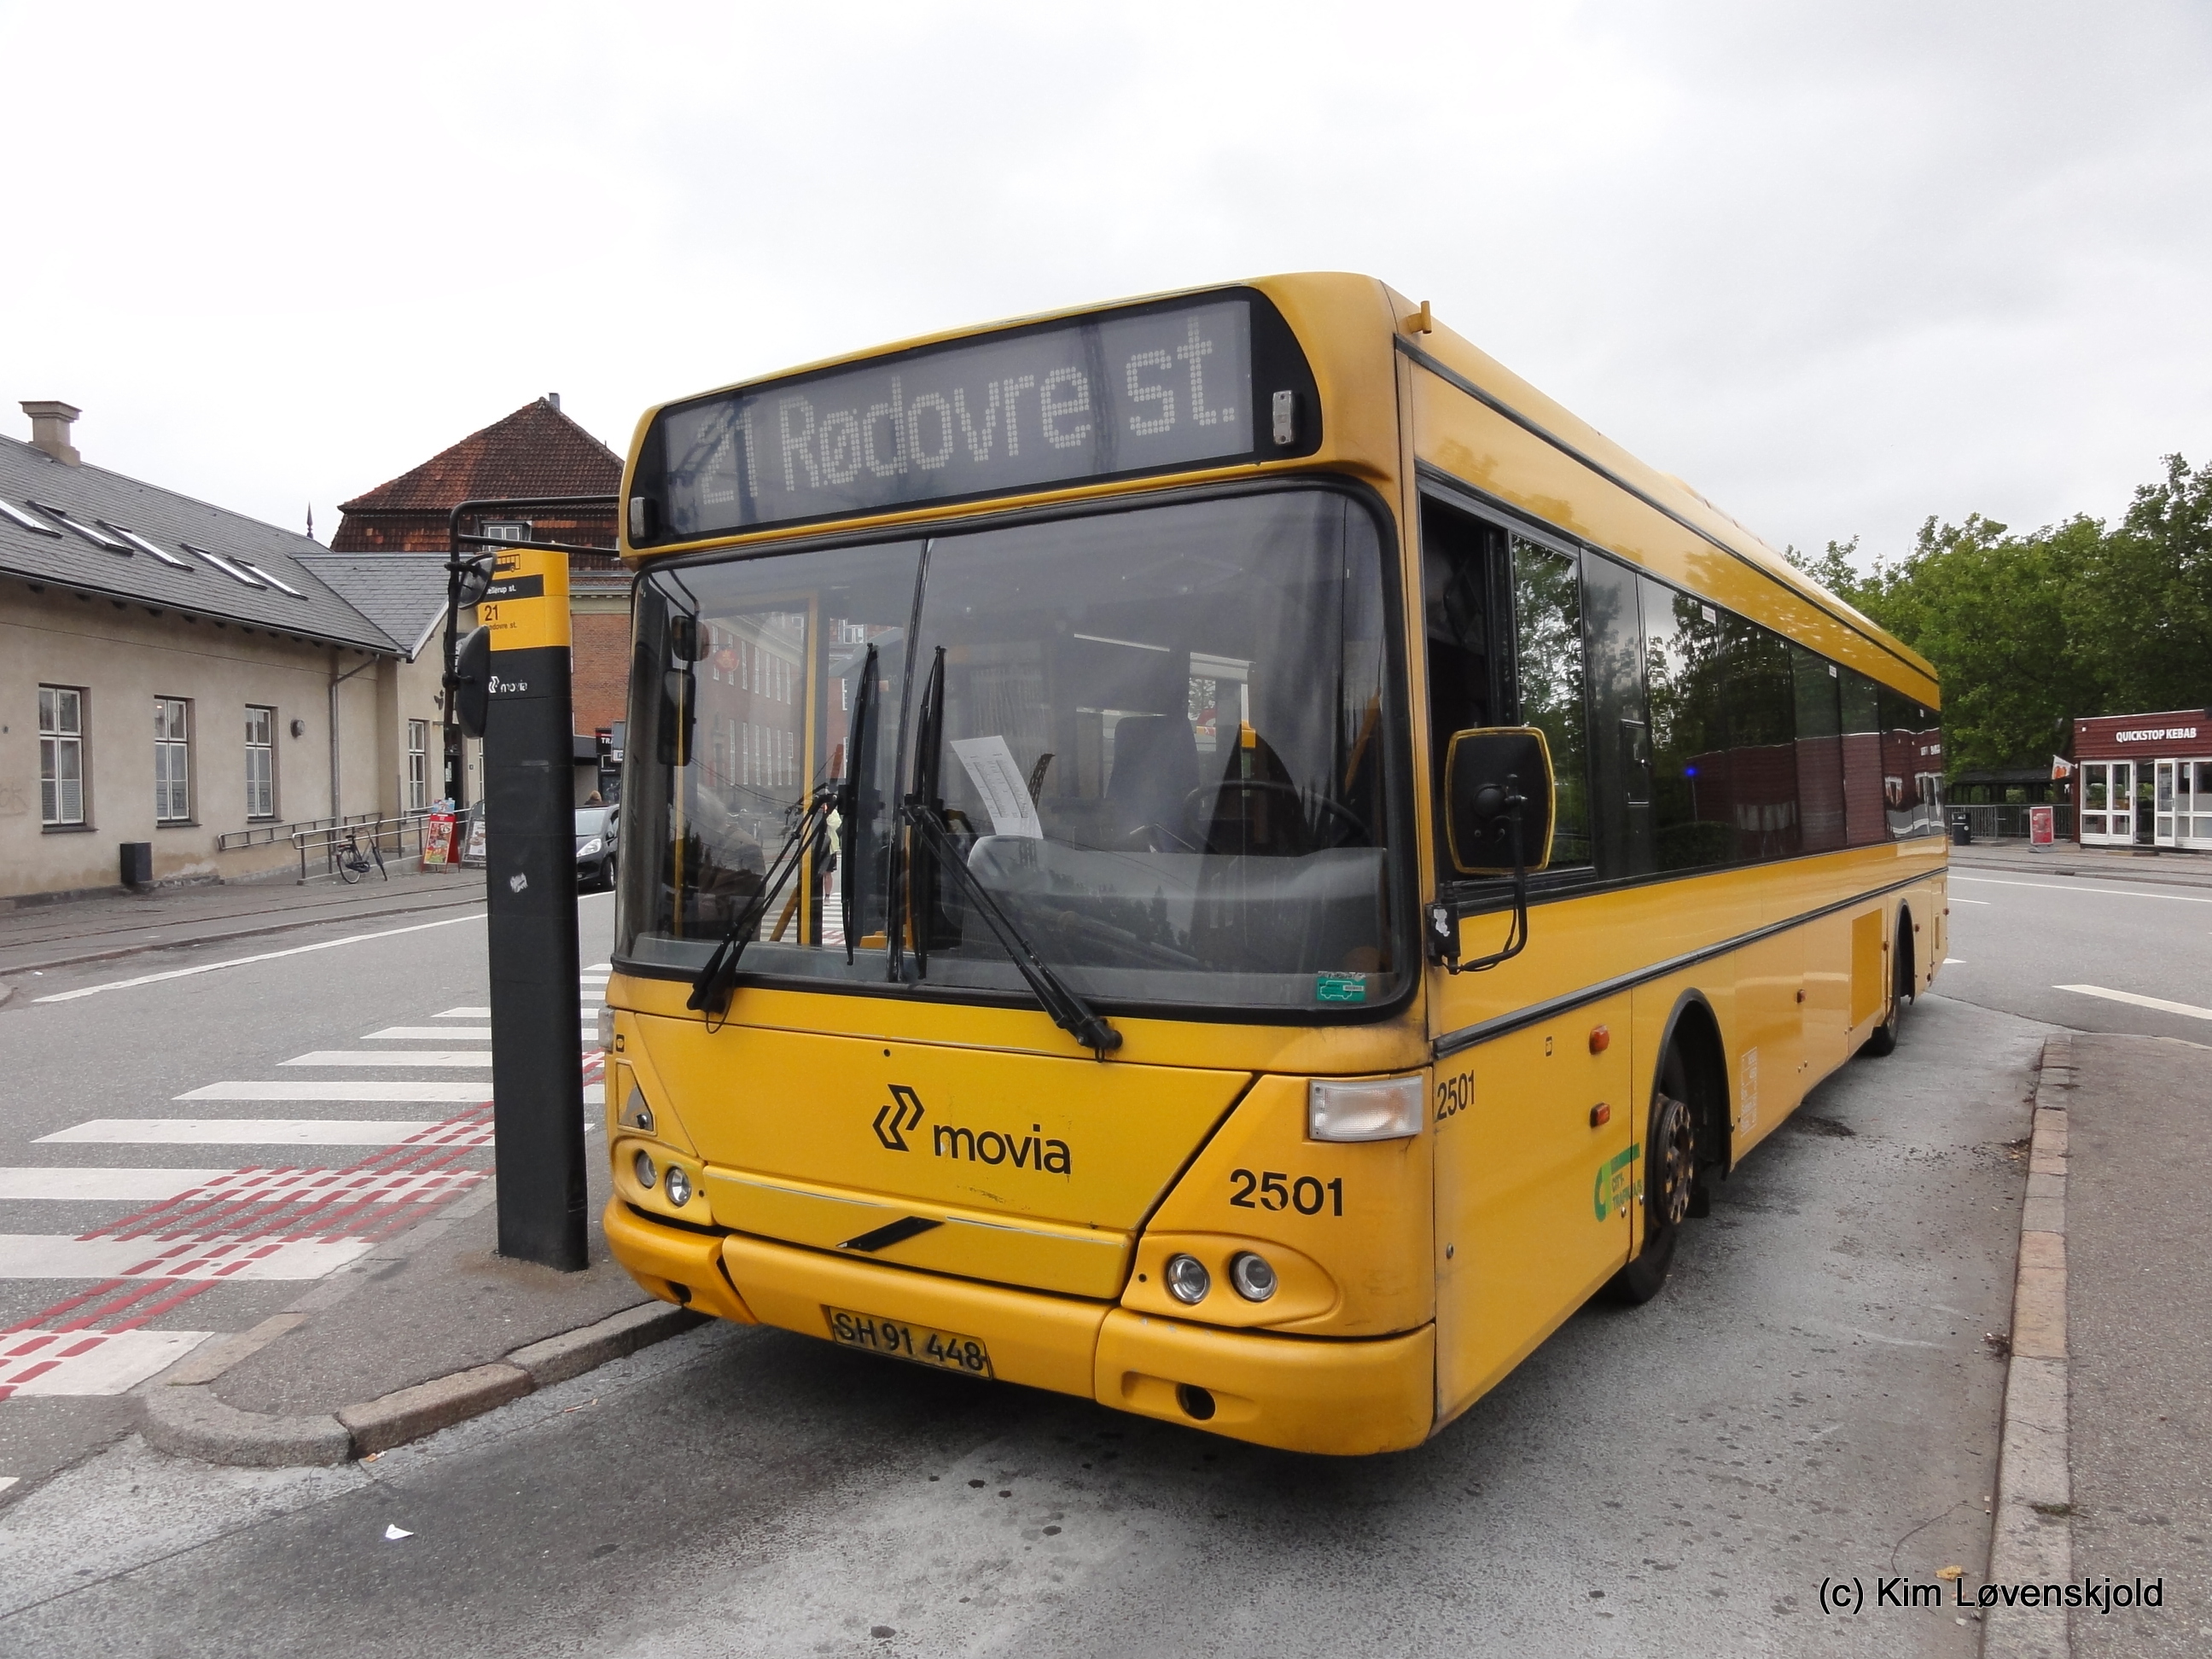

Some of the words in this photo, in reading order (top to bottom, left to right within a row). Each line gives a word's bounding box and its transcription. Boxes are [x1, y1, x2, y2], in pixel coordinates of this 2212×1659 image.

[698, 405, 758, 504] 21
[778, 366, 1092, 492] Rødovre
[1126, 315, 1235, 437] st.
[484, 603, 498, 621] 21
[2116, 729, 2165, 743] QUICKSTOP
[2165, 727, 2197, 740] KEBAB
[1436, 1068, 1474, 1121] 2501
[934, 1123, 1071, 1175] movia
[1230, 1168, 1342, 1216] 2501
[926, 1333, 984, 1371] 448
